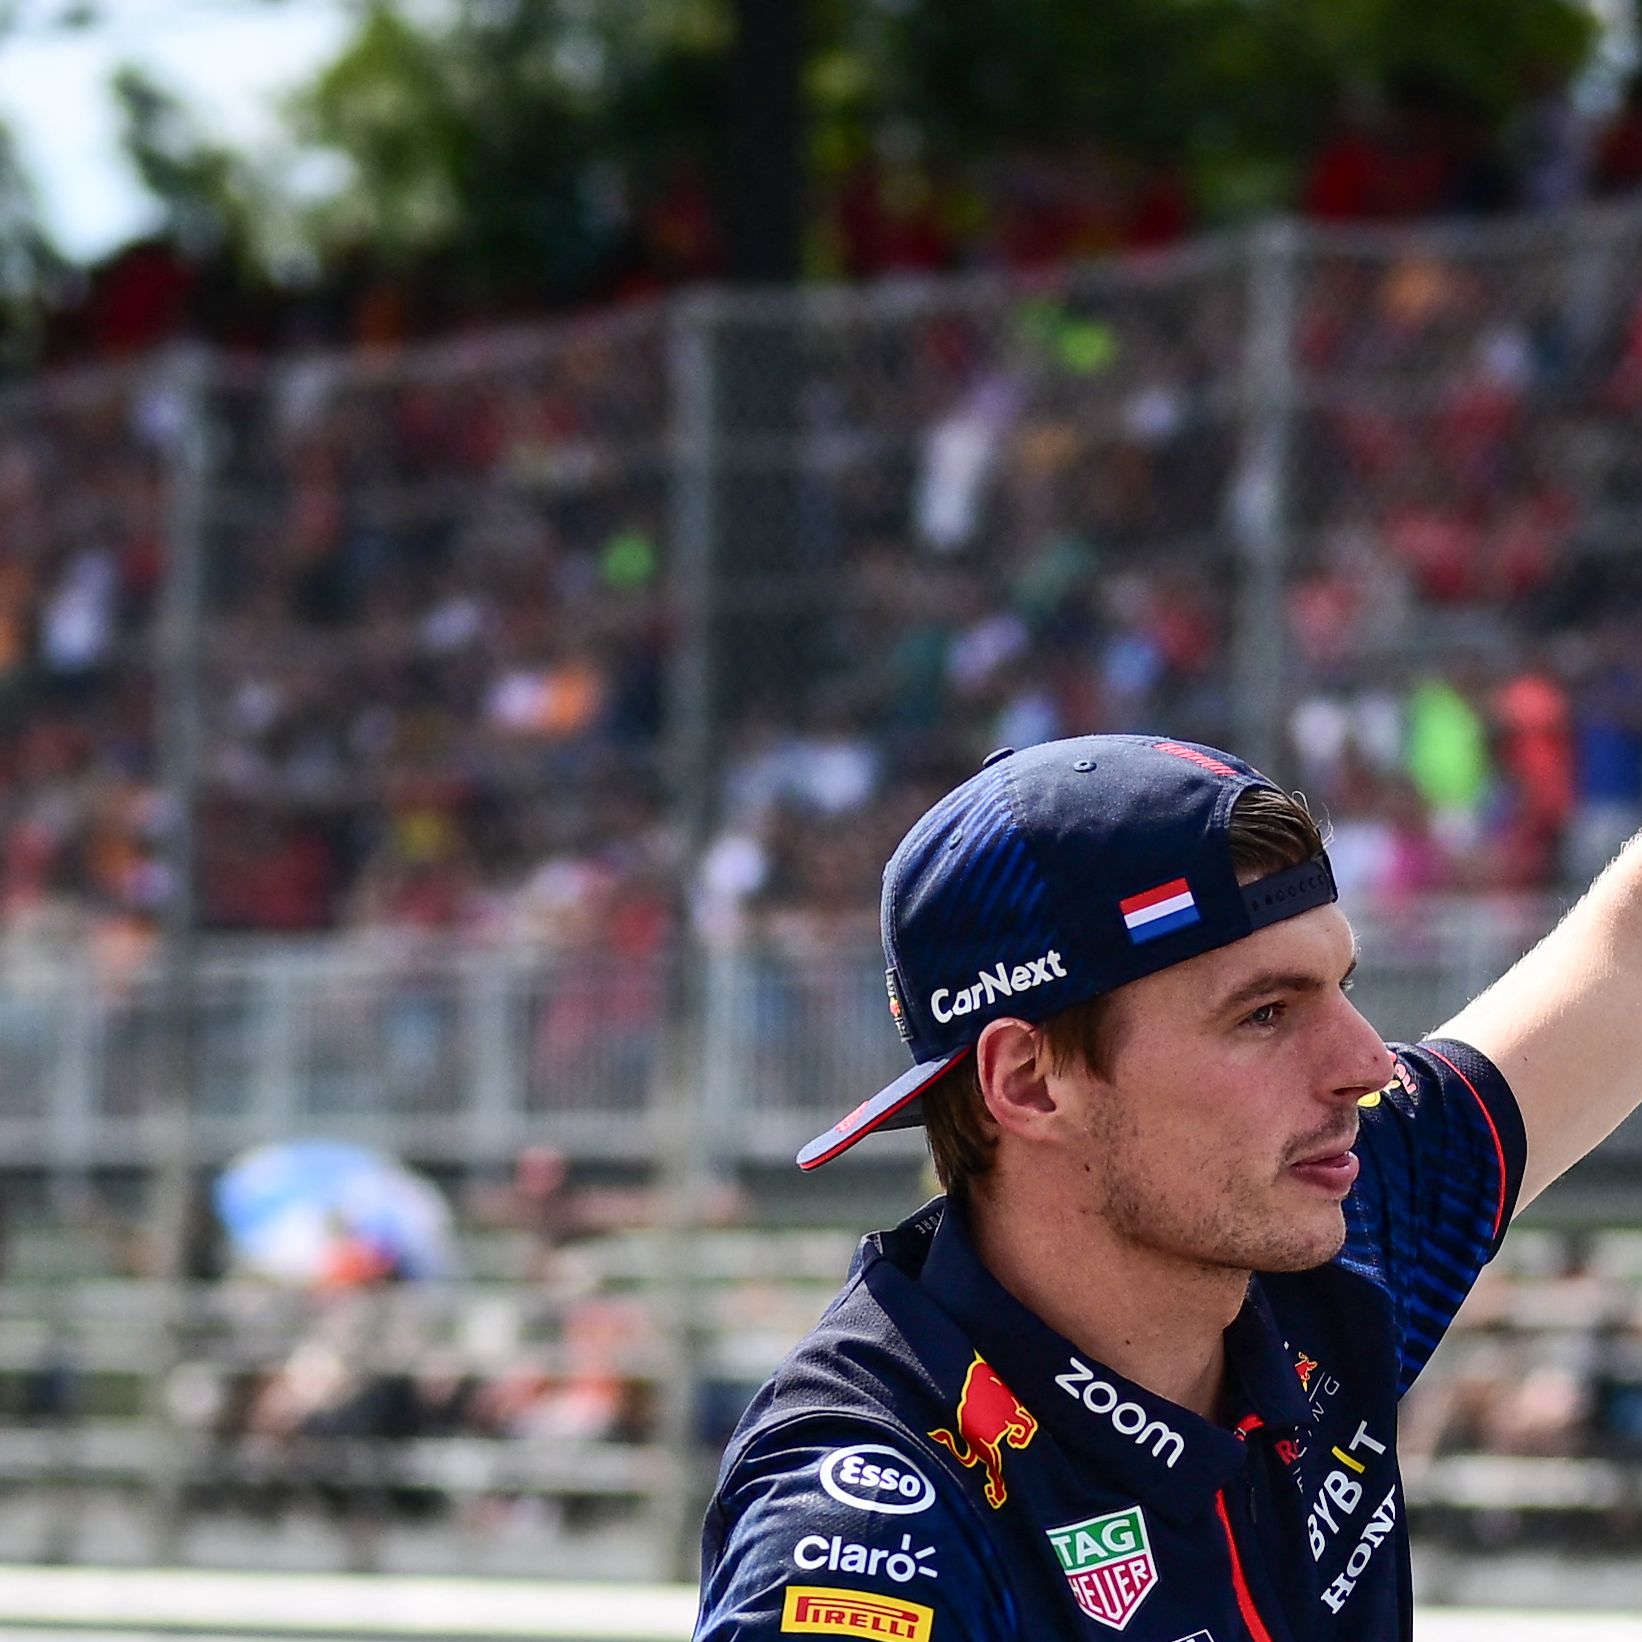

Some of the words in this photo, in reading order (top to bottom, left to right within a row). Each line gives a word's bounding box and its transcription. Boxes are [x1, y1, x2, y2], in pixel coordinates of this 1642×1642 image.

[931, 949, 1067, 1024] CarNext
[1055, 1357, 1184, 1468] zoom
[839, 1455, 921, 1498] Esso
[1307, 1420, 1387, 1562] BYBIT
[793, 1534, 917, 1583] Claro
[1052, 1518, 1137, 1568] TAG
[795, 1595, 920, 1640] PIRELLI
[1067, 1558, 1150, 1621] HEUER
